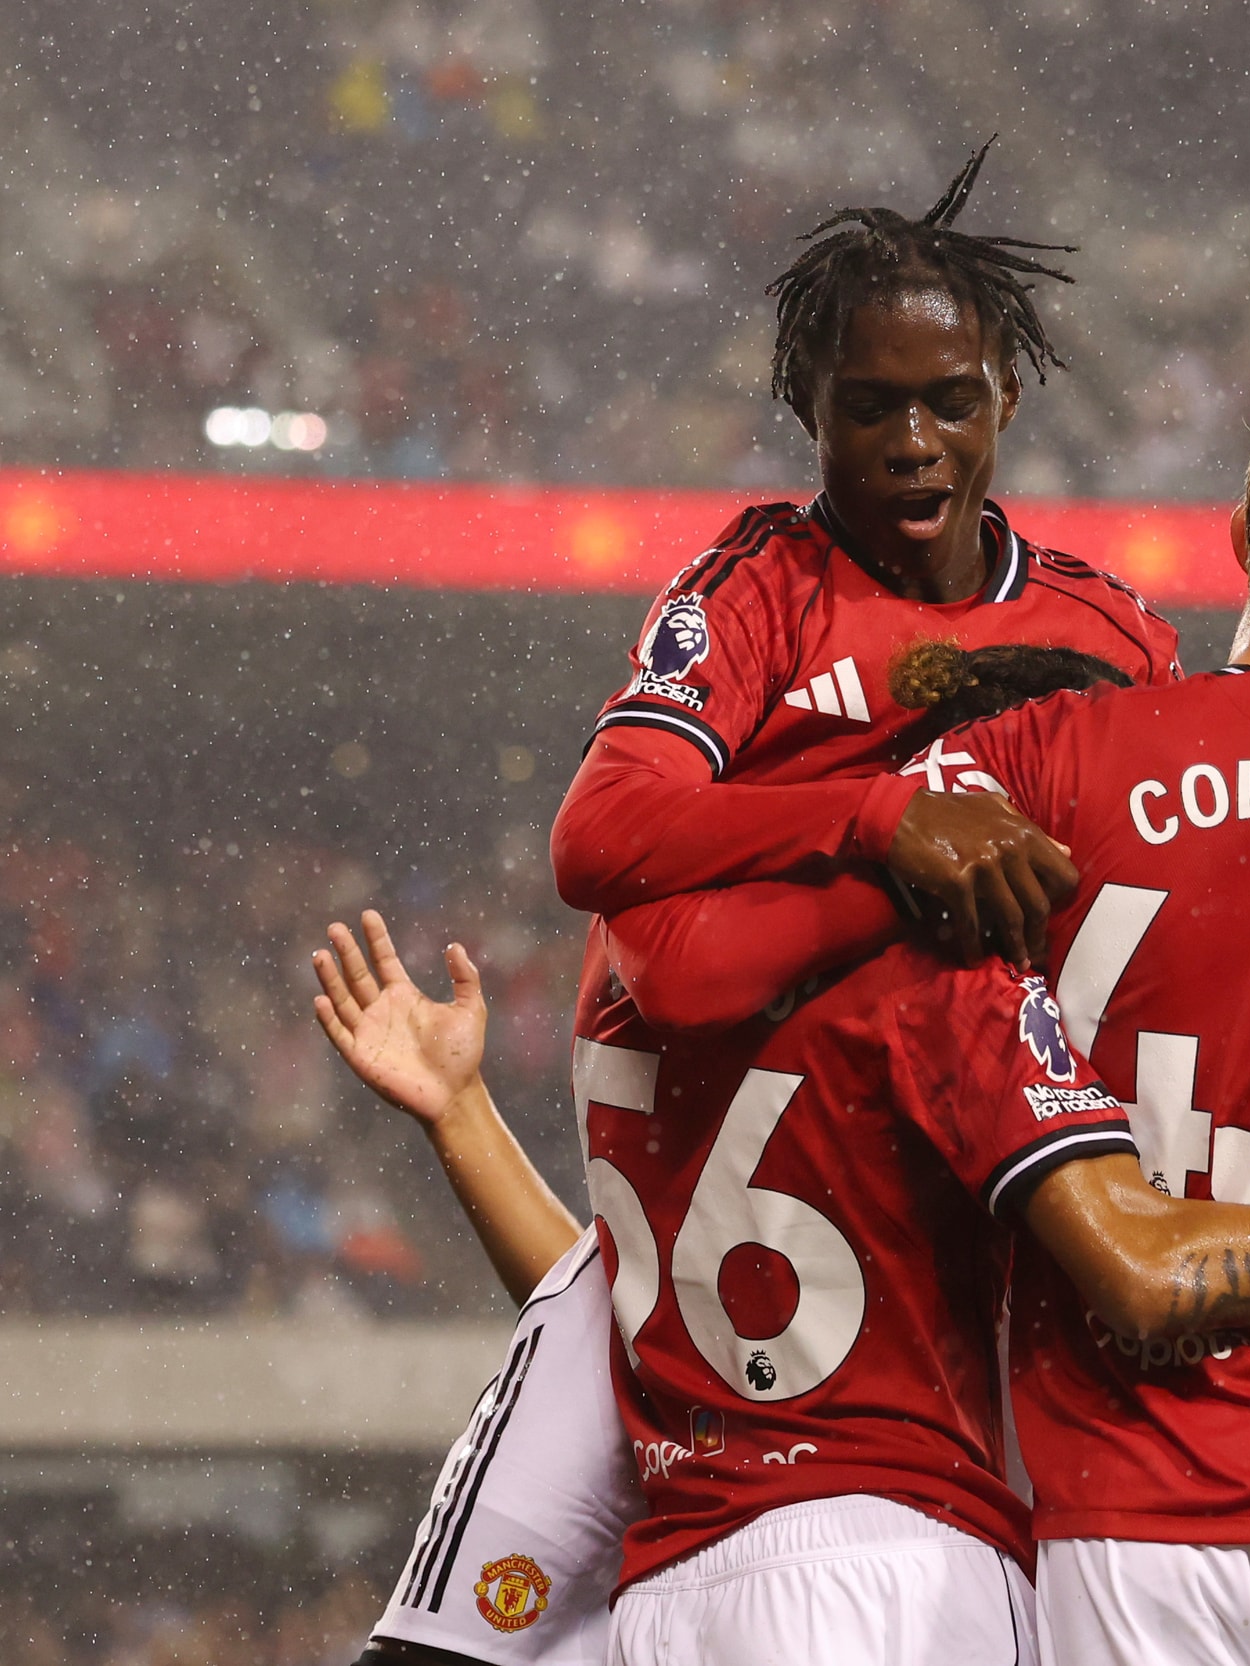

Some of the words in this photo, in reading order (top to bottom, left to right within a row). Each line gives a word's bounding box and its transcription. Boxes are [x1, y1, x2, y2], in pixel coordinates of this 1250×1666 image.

[1022, 1083, 1055, 1107] No
[1053, 1086, 1104, 1102] room
[1031, 1099, 1063, 1122] For
[1060, 1094, 1121, 1113] racism
[572, 1034, 866, 1402] 56
[487, 1560, 545, 1592] MANCHESTER
[486, 1609, 527, 1627] UNITED
